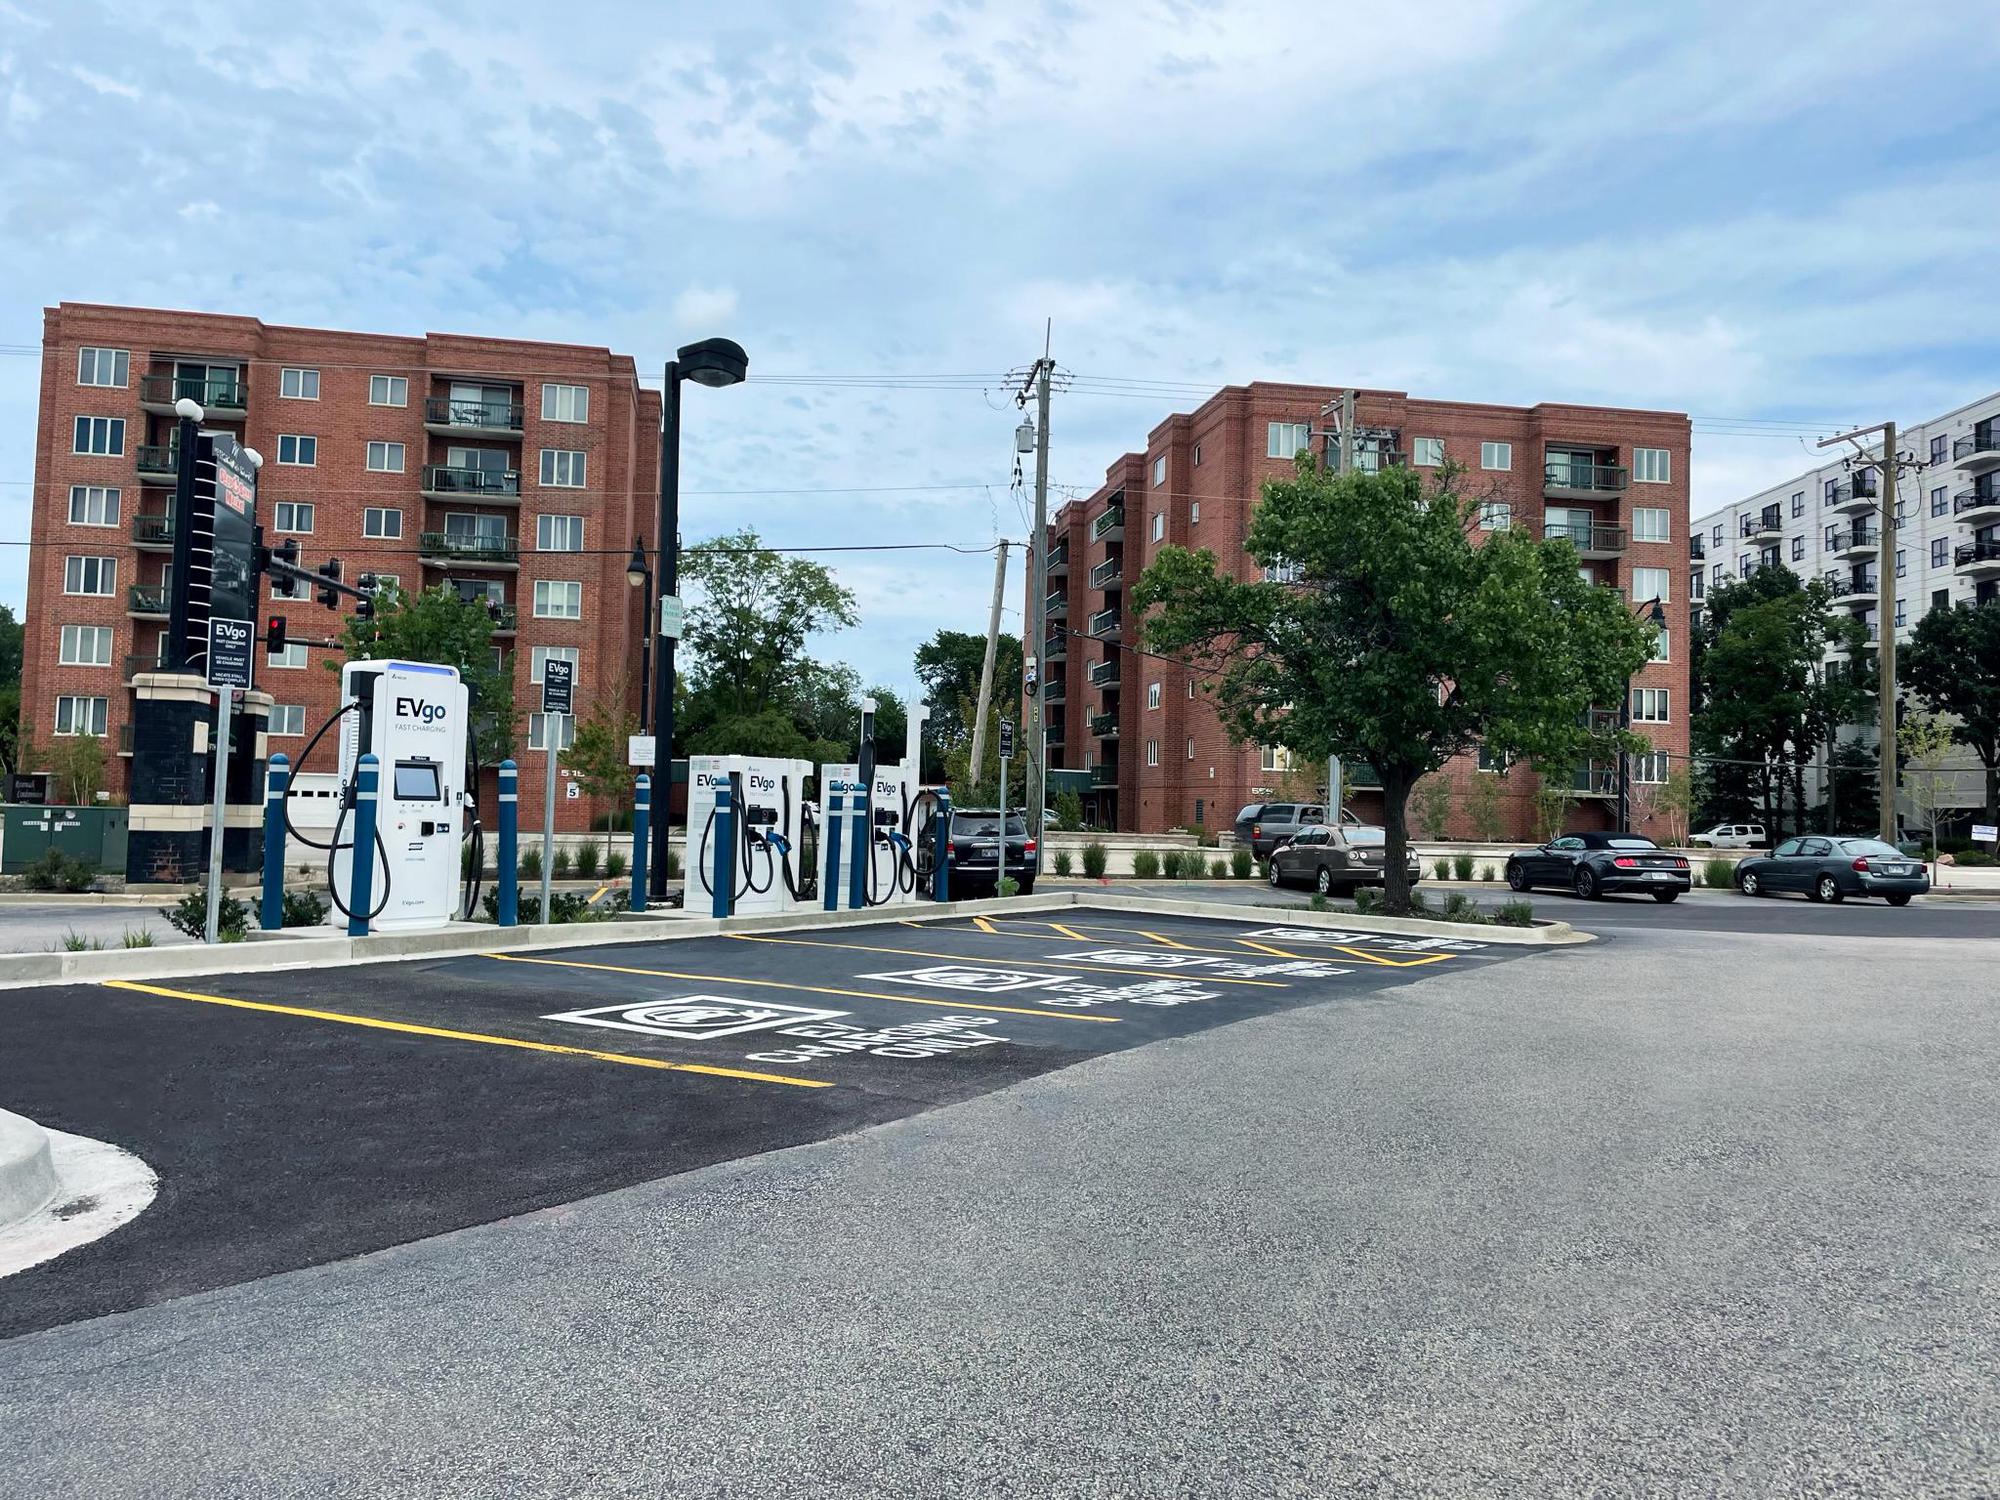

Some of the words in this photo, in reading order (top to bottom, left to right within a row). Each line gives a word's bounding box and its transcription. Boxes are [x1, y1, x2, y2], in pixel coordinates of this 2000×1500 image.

[216, 624, 247, 640] EVgo
[549, 662, 569, 675] EVgo
[396, 697, 446, 724] EVgo
[412, 725, 446, 733] CHARGING
[697, 774, 717, 790] EVg
[750, 776, 775, 791] EVgo
[829, 780, 856, 794] Ego
[877, 782, 896, 795] EVgo
[569, 788, 576, 797] 5
[776, 1022, 866, 1039] EV
[745, 1015, 999, 1063] CHARGING
[869, 1030, 1010, 1058] ONLY
